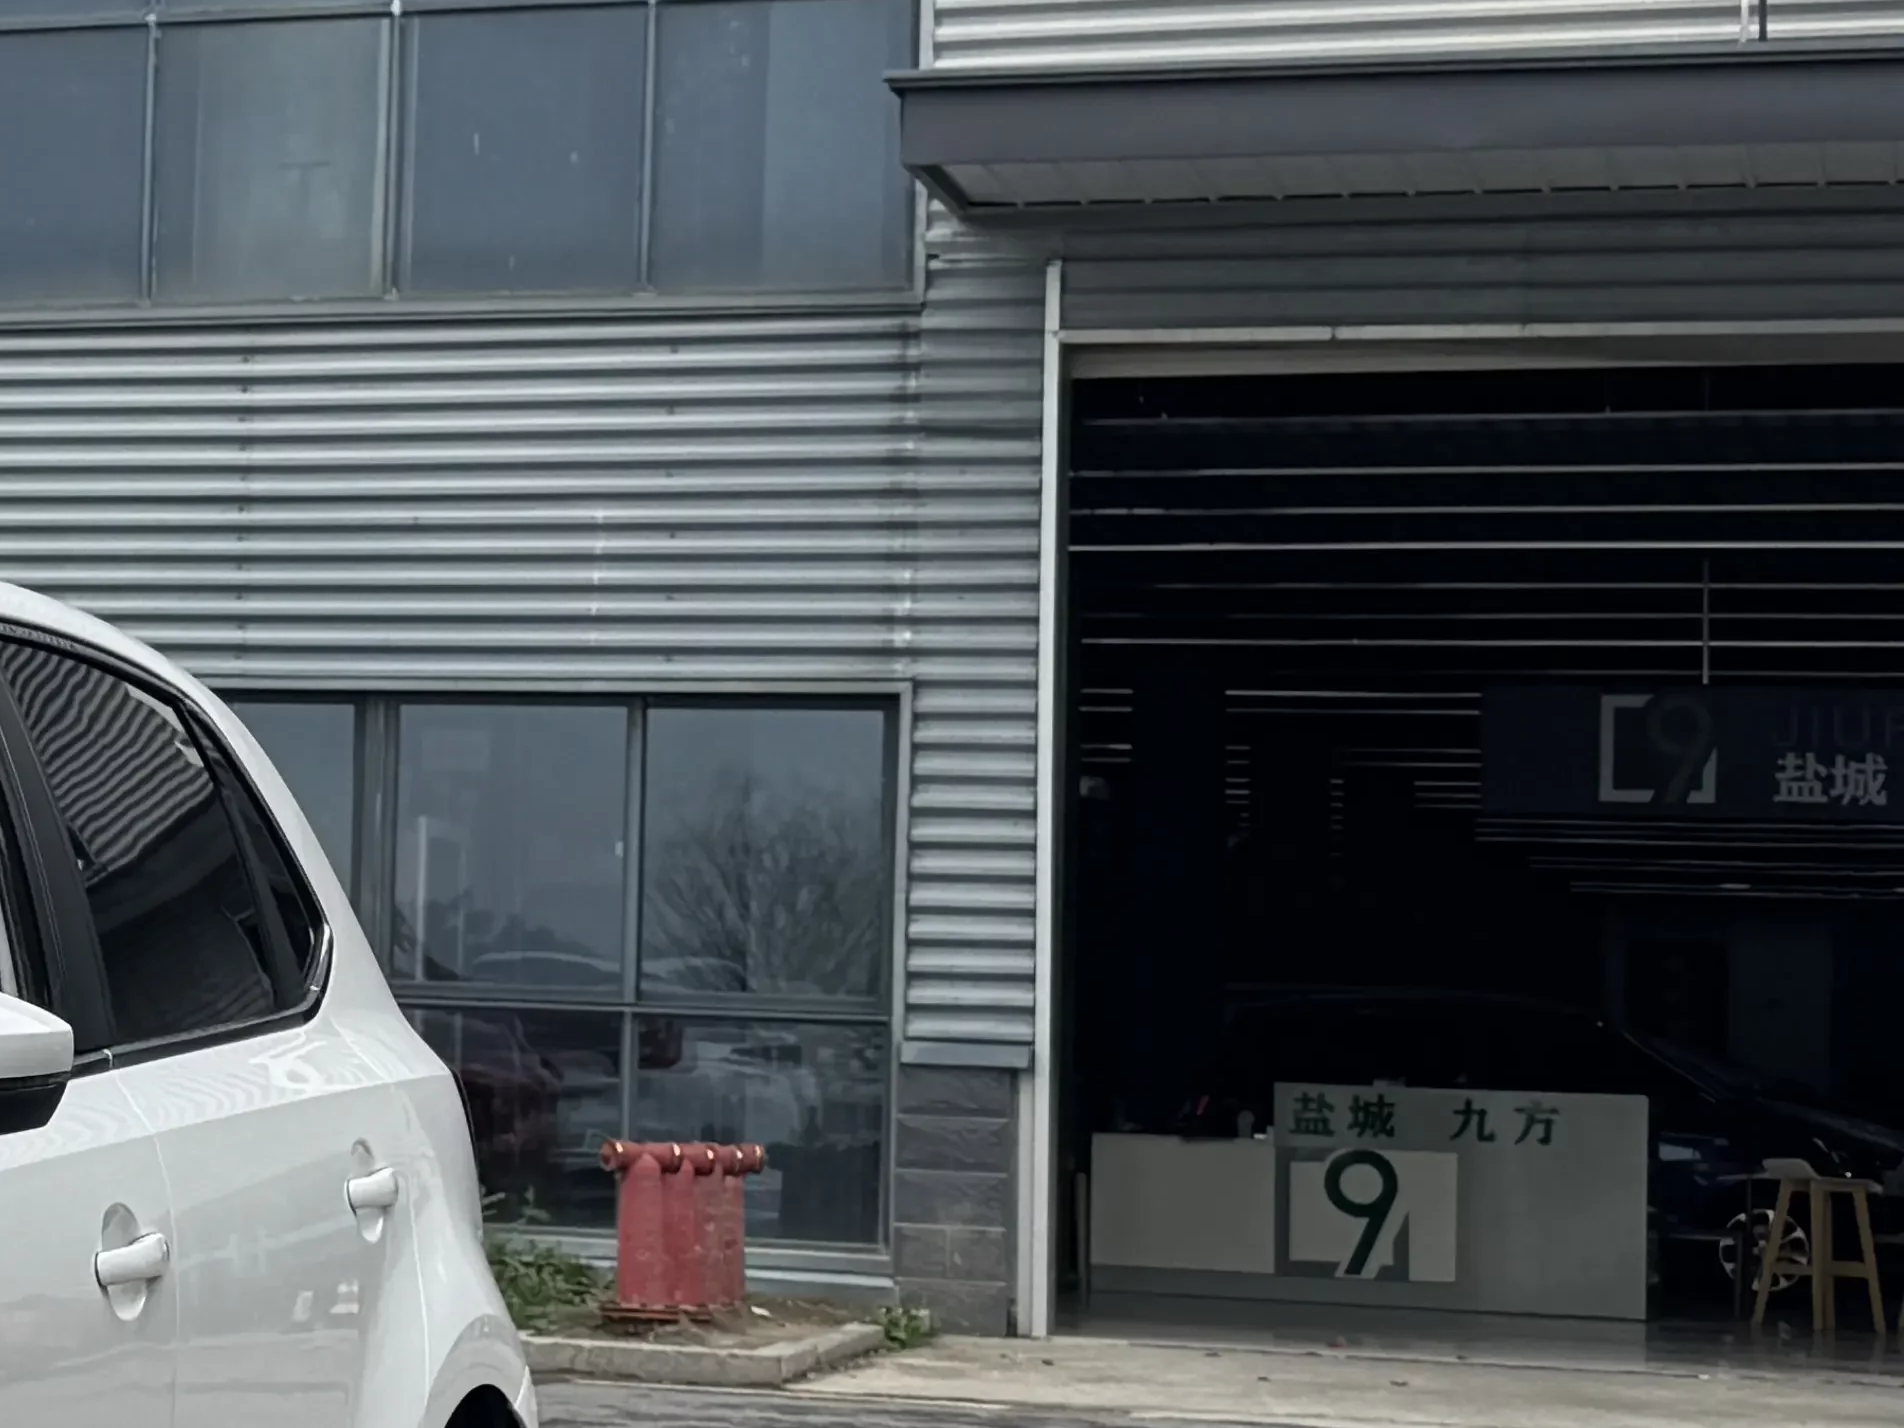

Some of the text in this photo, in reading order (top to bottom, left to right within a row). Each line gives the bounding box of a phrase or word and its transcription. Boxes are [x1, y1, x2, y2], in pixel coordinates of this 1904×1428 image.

[1772, 751, 1889, 806] 盐城
[1289, 1091, 1561, 1146] 盐城 九方
[1324, 1149, 1398, 1275] 9
